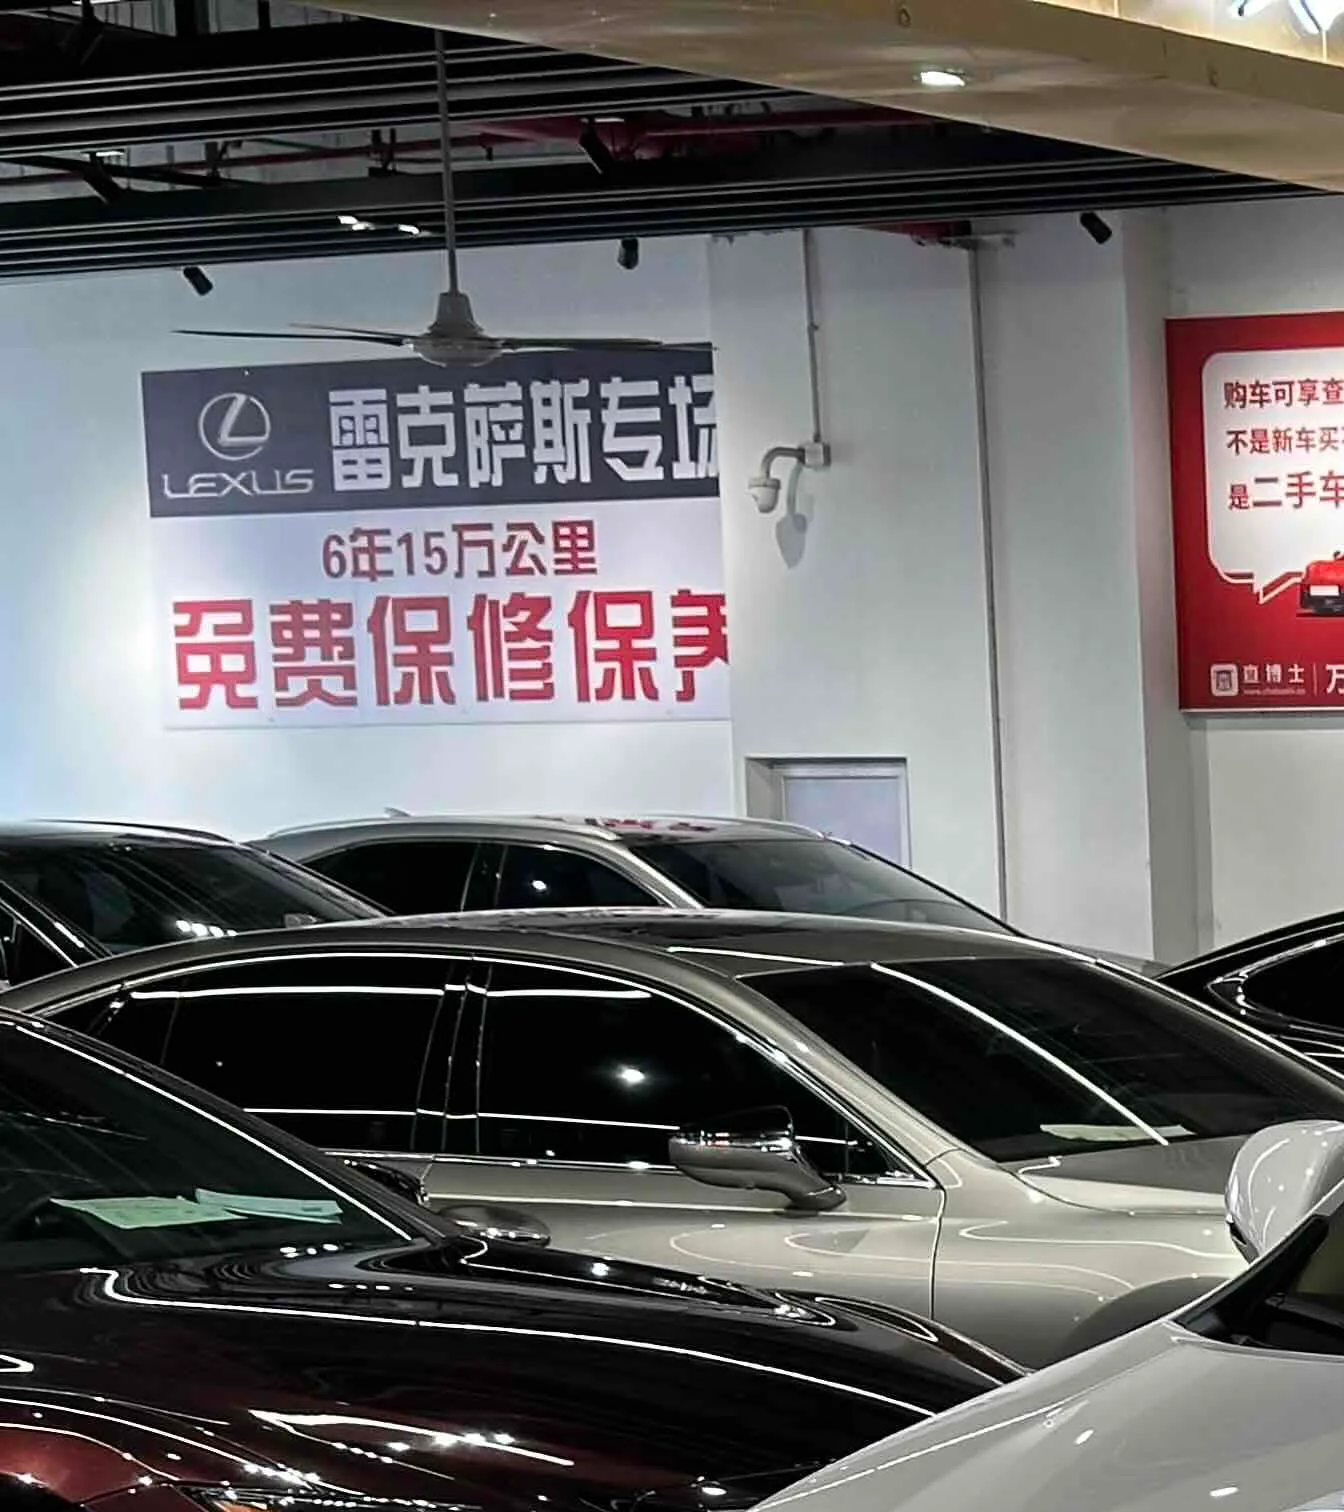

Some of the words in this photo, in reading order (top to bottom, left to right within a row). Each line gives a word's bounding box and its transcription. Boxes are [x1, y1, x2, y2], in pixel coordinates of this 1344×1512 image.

[329, 374, 720, 491] 雷克萨斯专场
[162, 469, 315, 499] LEXUS
[321, 519, 598, 582] 6年15万公里
